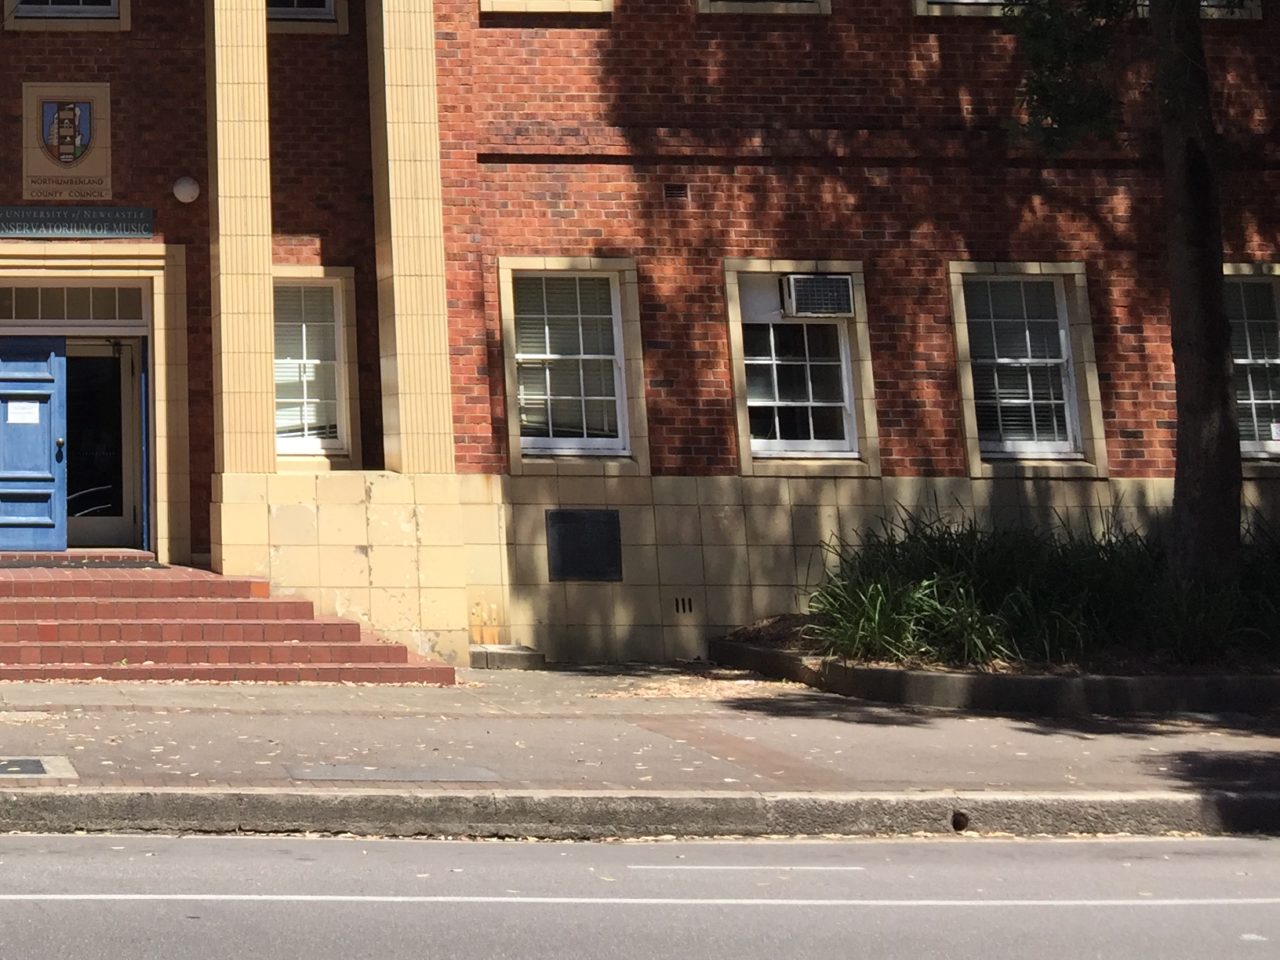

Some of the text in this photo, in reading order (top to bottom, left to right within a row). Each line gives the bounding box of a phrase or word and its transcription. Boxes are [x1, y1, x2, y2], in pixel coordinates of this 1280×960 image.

[30, 177, 104, 186] NORTHUMBERLAND
[30, 190, 105, 198] COUNTY COUNCIL
[6, 210, 69, 219] UNIVERSITY
[71, 209, 80, 220] of
[83, 210, 145, 219] NEWCASTLE
[94, 222, 109, 234] OF
[112, 222, 149, 234] MUSIC
